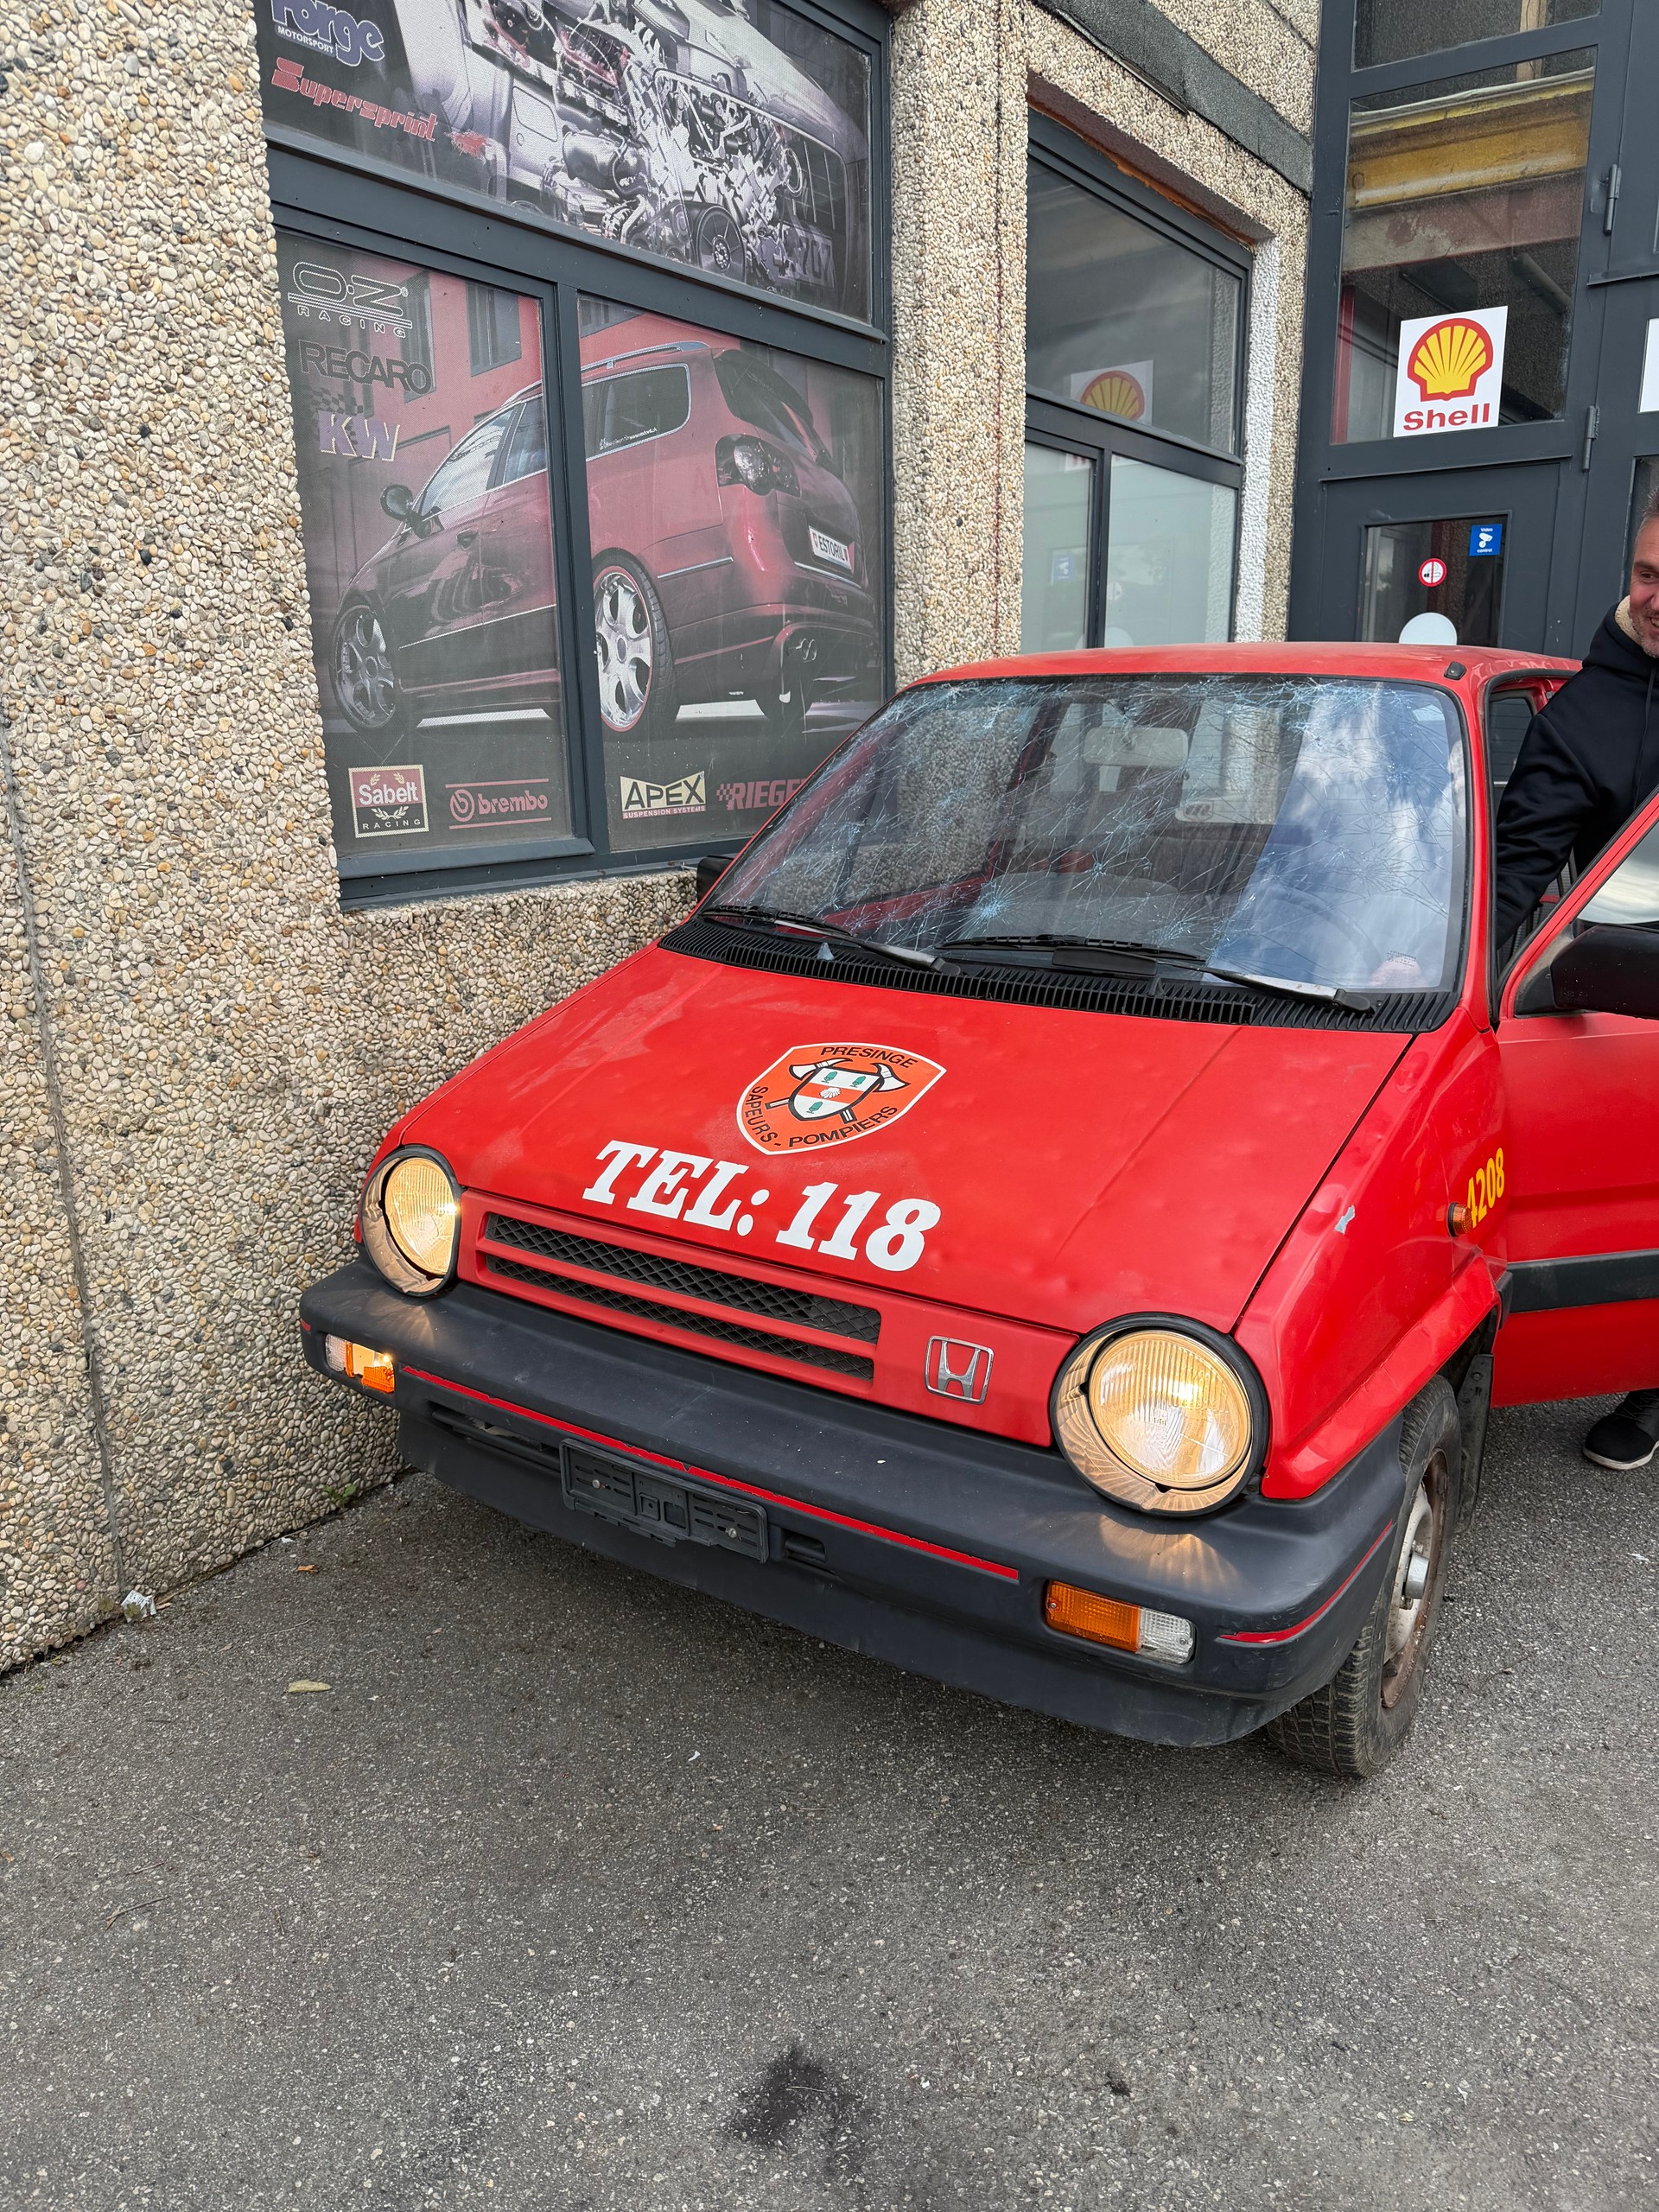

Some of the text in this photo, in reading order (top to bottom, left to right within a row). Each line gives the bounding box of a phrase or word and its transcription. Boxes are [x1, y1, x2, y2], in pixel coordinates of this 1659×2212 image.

[277, 26, 334, 54] MOTORSPORT
[271, 57, 438, 142] Supersprint
[297, 305, 406, 338] RACING
[298, 340, 432, 395] RECARO
[1403, 403, 1491, 430] Shell
[318, 410, 401, 461] KW
[359, 782, 419, 805] Sabelt
[478, 790, 548, 814] brembo
[624, 774, 704, 810] APEX
[728, 779, 810, 810] RIEGE
[362, 818, 422, 830] RACING
[623, 805, 706, 819] SUSPENSION SYSTEMS
[821, 1046, 918, 1068] PRESINGE
[789, 1106, 898, 1147] POMPIERS
[1467, 1147, 1504, 1229] 4208
[582, 1140, 942, 1271] TEL: 118
